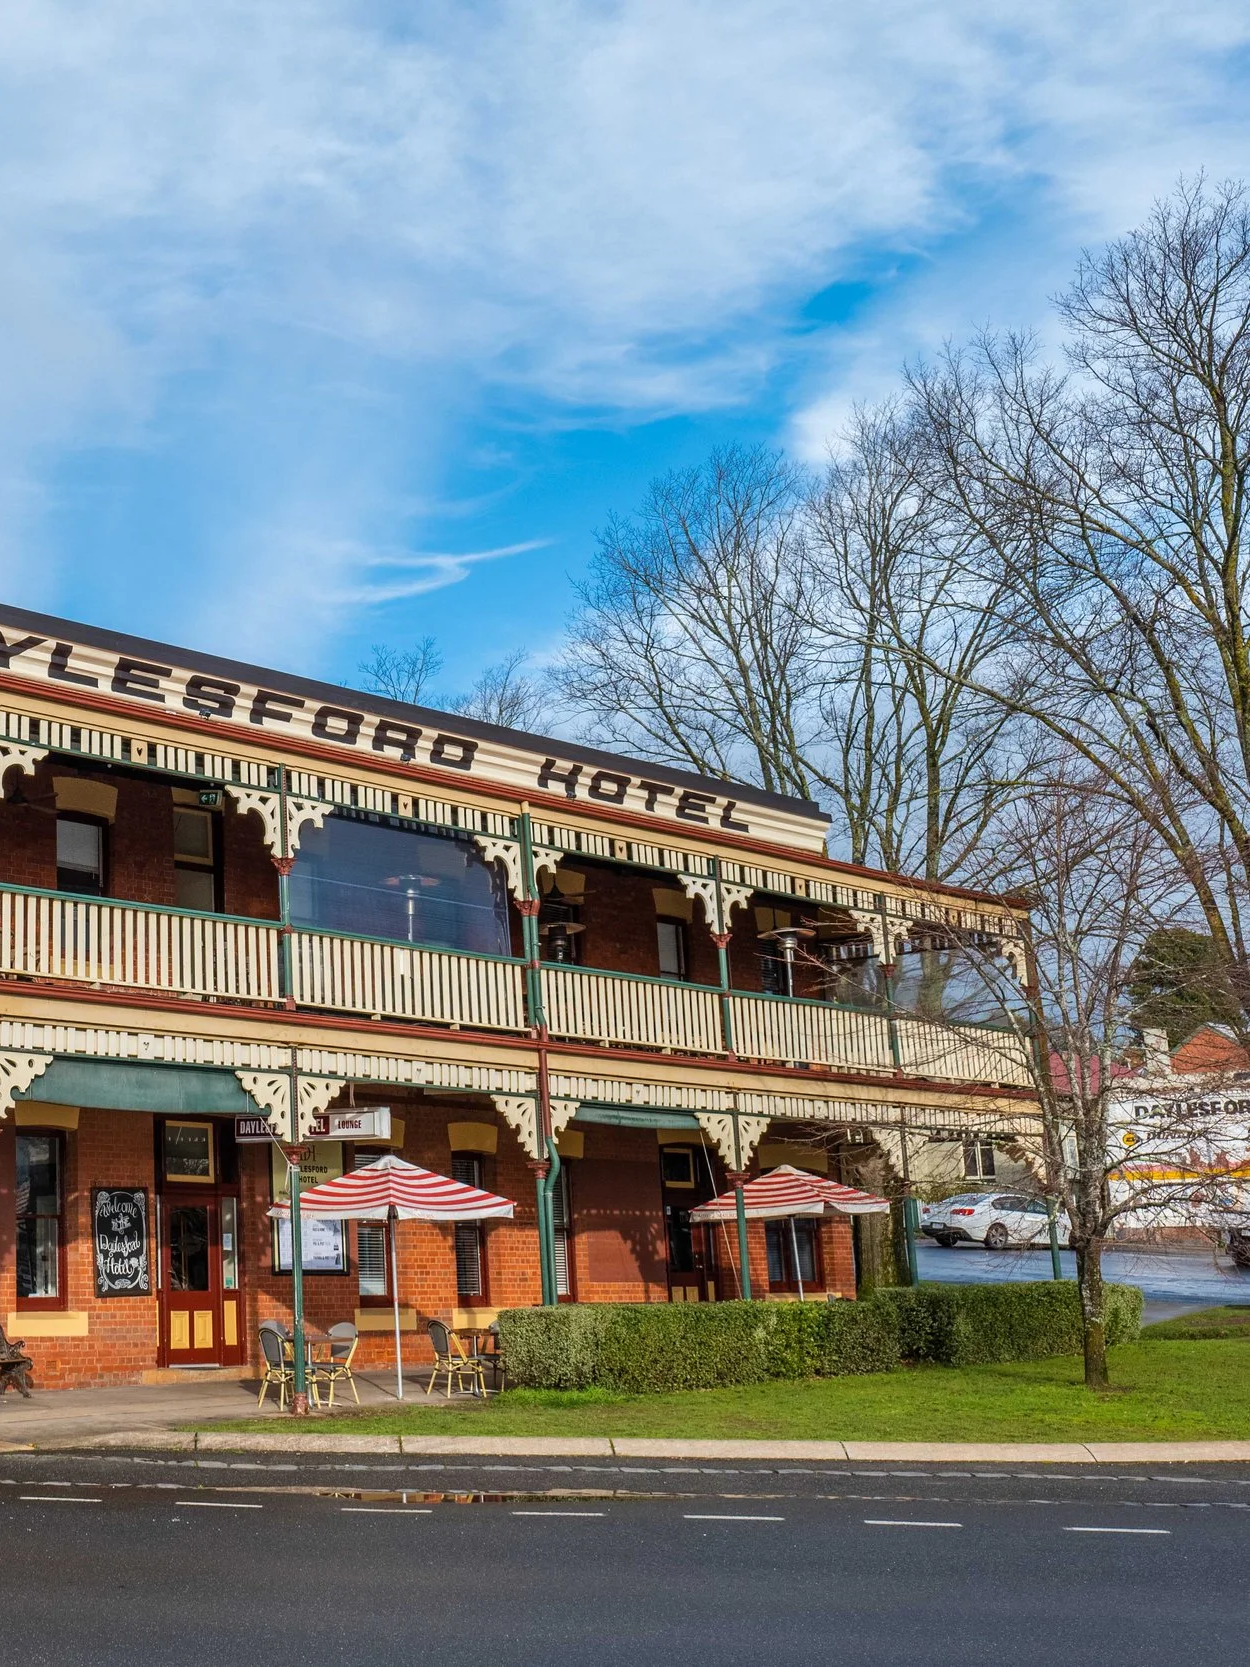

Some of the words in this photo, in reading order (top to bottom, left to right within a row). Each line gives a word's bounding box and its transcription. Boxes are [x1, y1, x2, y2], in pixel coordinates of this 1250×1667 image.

[537, 757, 749, 833] HOTEL
[337, 1119, 362, 1130] LOUNGE
[299, 1165, 328, 1174] LESFORD
[99, 1196, 138, 1218] Welcome
[100, 1230, 141, 1257] Daylesford
[103, 1257, 132, 1275] Hotel
